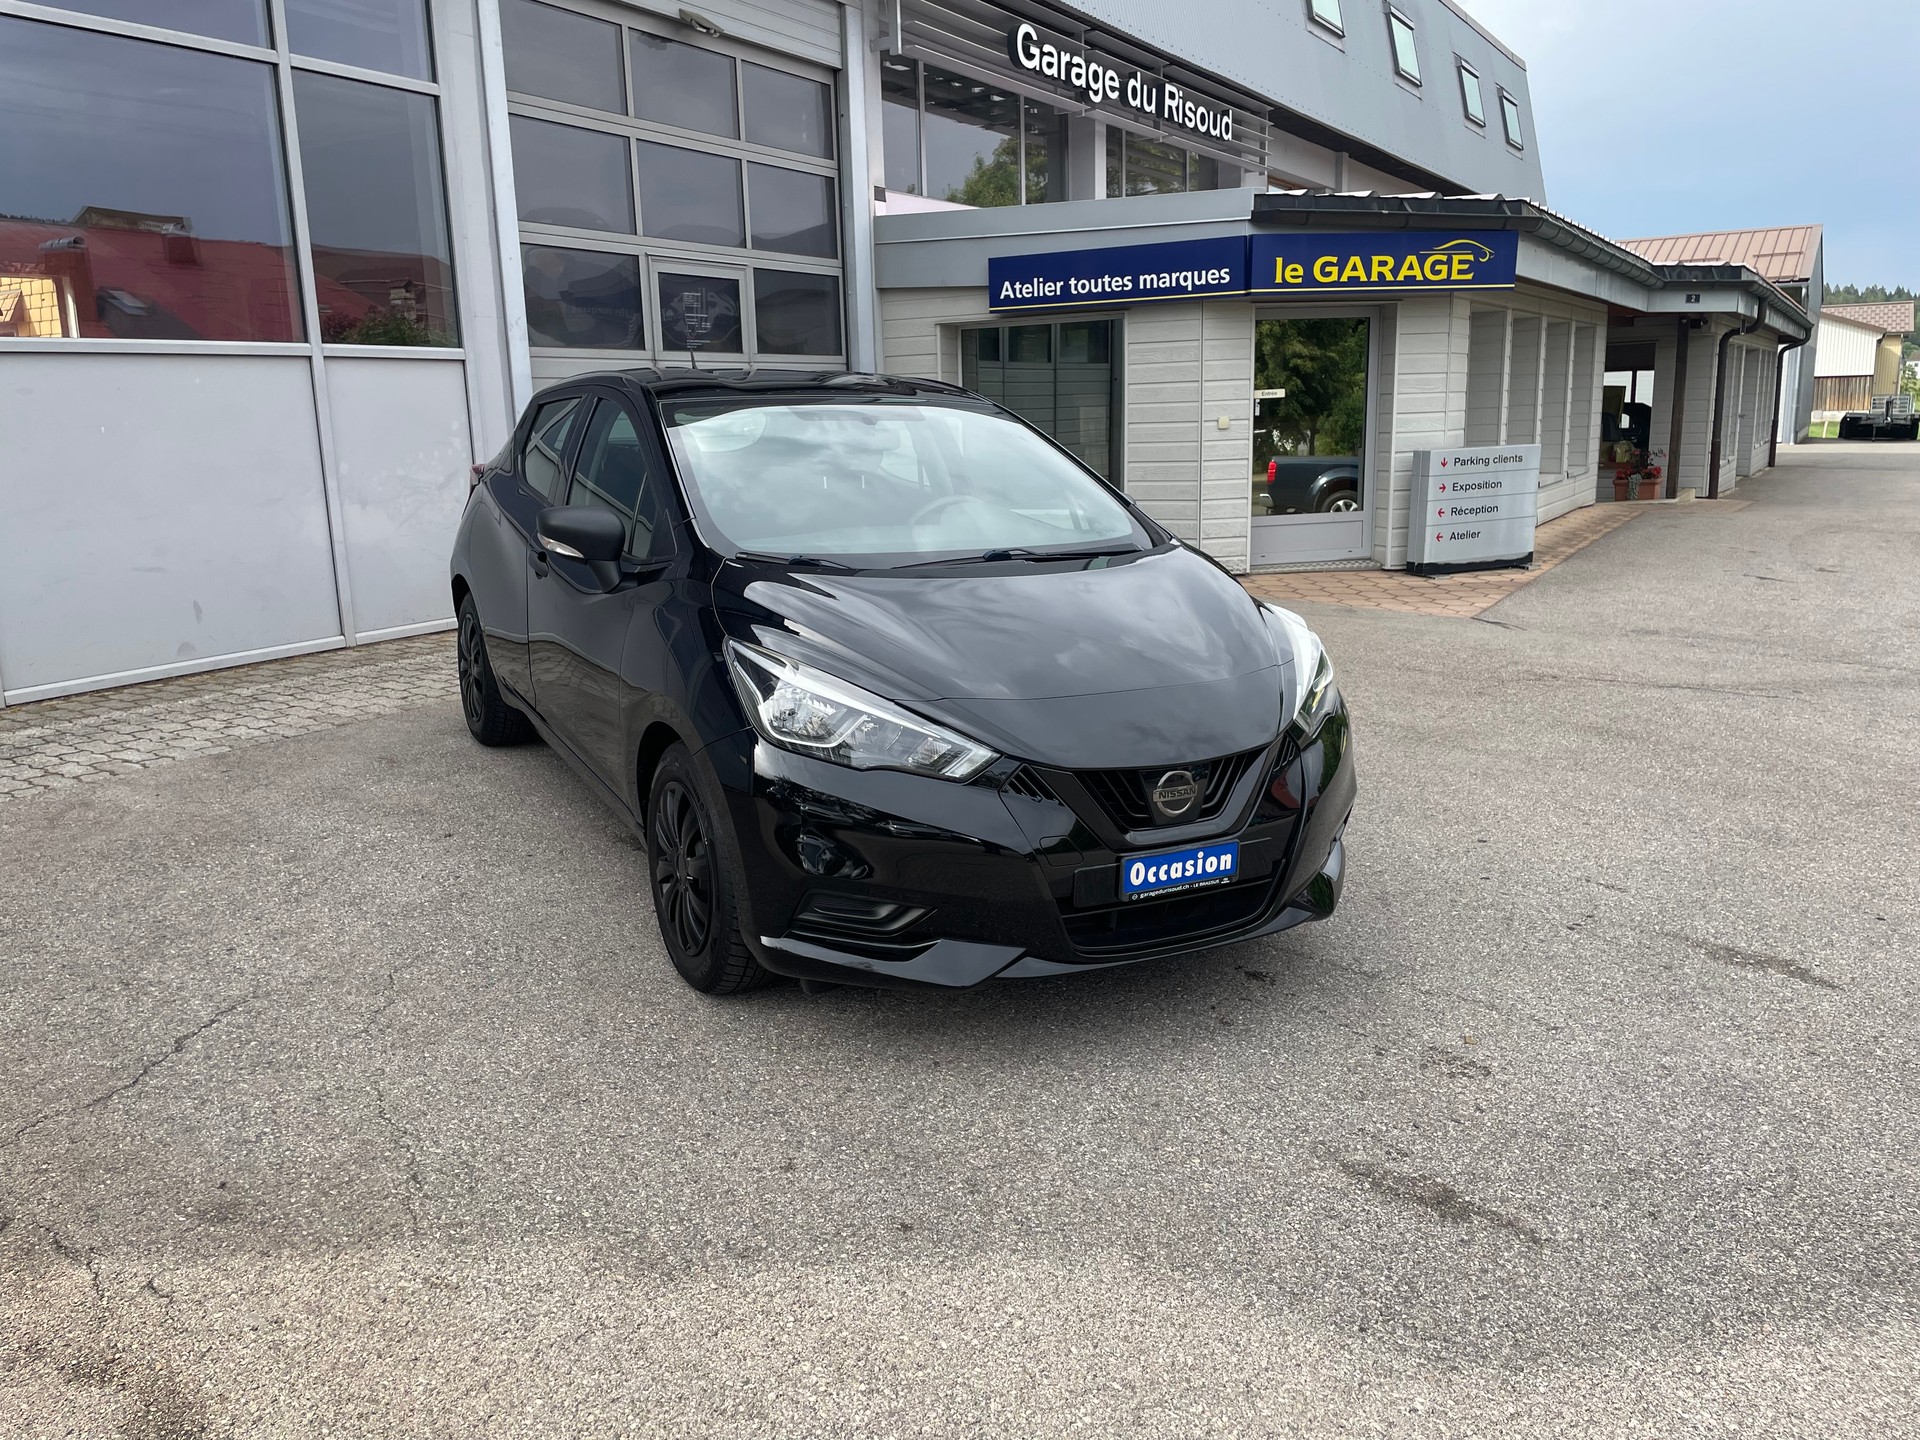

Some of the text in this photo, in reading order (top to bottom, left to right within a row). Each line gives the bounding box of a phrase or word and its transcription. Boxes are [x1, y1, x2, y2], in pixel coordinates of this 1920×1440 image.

[1016, 23, 1233, 141] Garage du Risoud
[1274, 253, 1475, 284] le GARAGE
[999, 264, 1231, 300] Atelier toutes marques
[1454, 454, 1523, 466] Parking clients
[1452, 480, 1502, 492] Exposition
[1451, 504, 1498, 516] Réception
[1449, 530, 1481, 541] Atelier
[1158, 787, 1196, 799] NISSAN
[1130, 851, 1232, 886] Occasion
